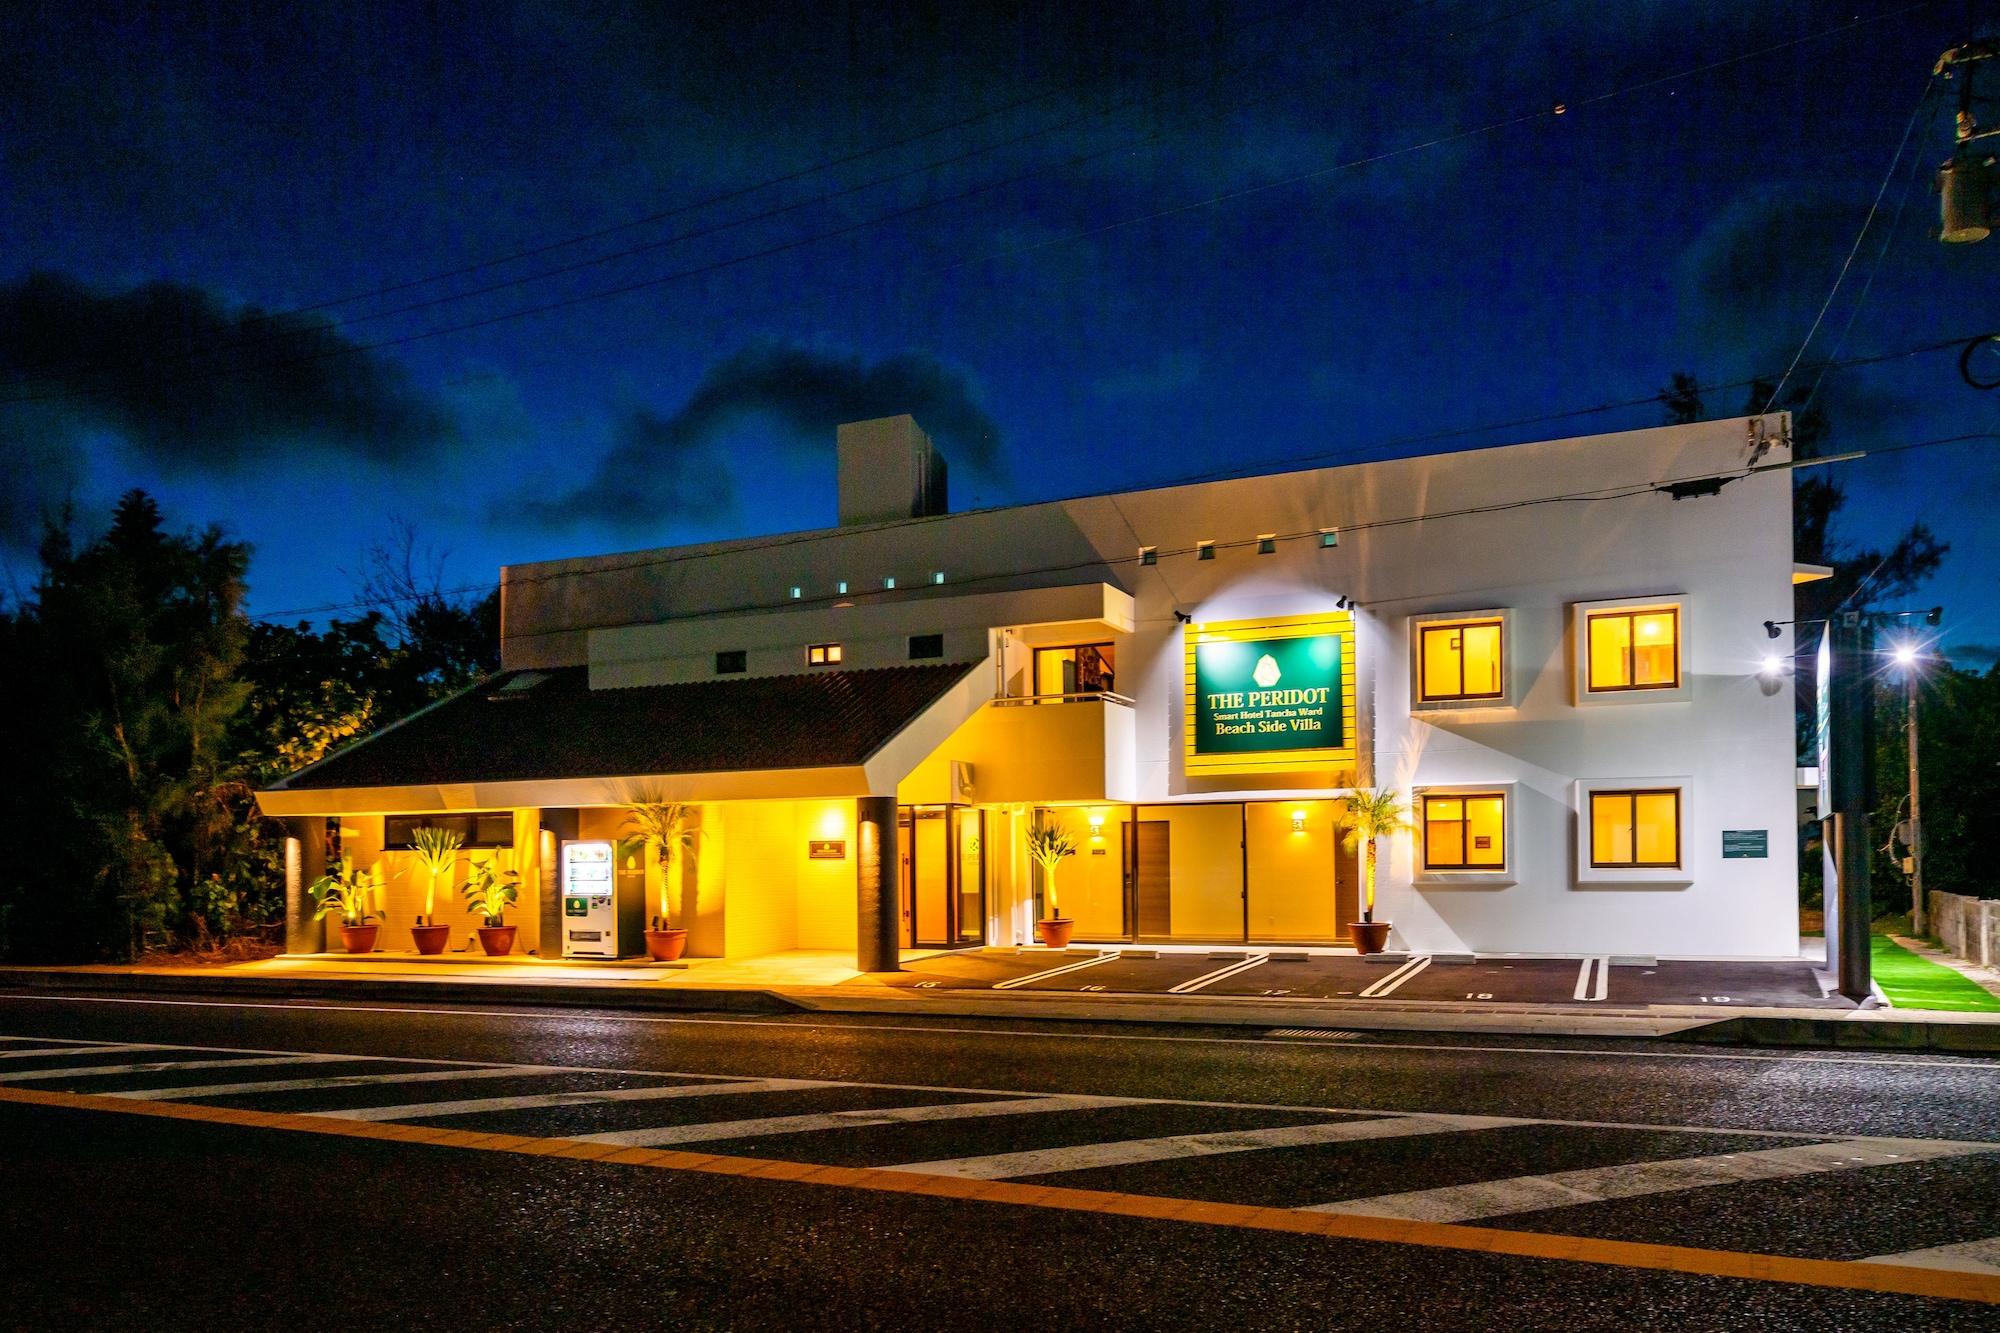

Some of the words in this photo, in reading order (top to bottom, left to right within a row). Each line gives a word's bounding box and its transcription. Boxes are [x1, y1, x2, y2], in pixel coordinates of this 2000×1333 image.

[1208, 693, 1244, 709] THE
[1248, 688, 1329, 707] PERIDOT
[1213, 711, 1239, 721] Smart
[1240, 710, 1264, 720] Hotel
[1265, 708, 1297, 718] Tancha
[1298, 707, 1323, 717] Ward
[1215, 721, 1256, 735] Beach
[1258, 719, 1288, 733] Side
[1289, 718, 1322, 732] Villa
